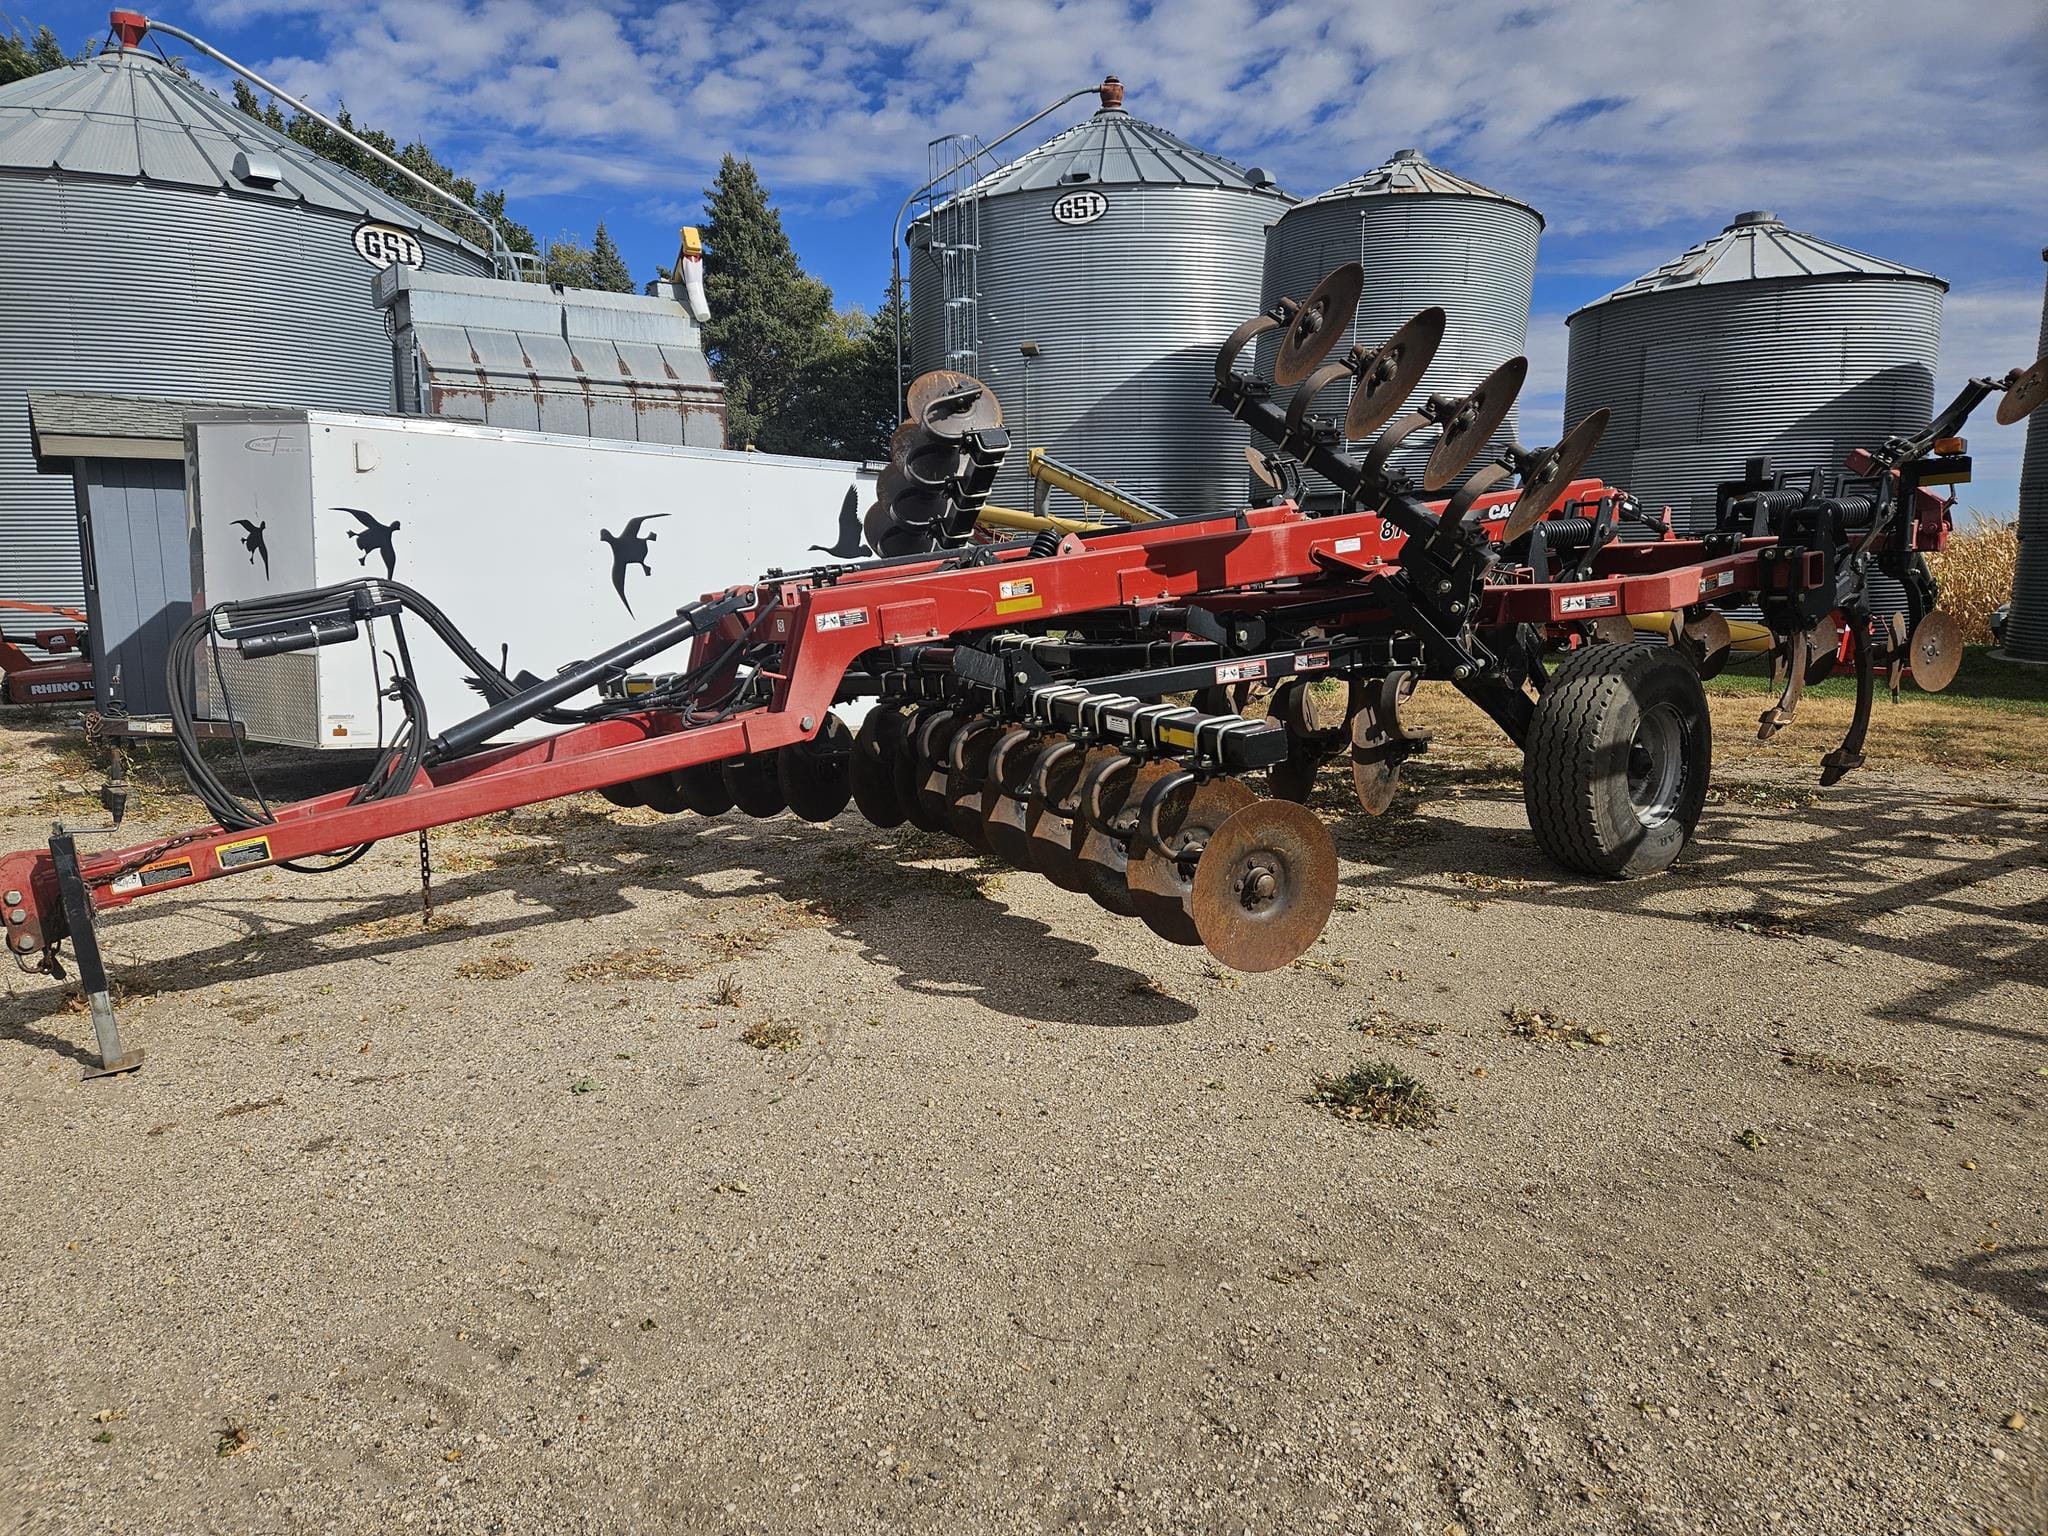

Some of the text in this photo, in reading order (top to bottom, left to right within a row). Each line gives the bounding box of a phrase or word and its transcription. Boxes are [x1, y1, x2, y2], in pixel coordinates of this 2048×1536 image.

[1060, 196, 1100, 218] GSI
[364, 231, 417, 265] GSI
[31, 681, 80, 695] RHINO
